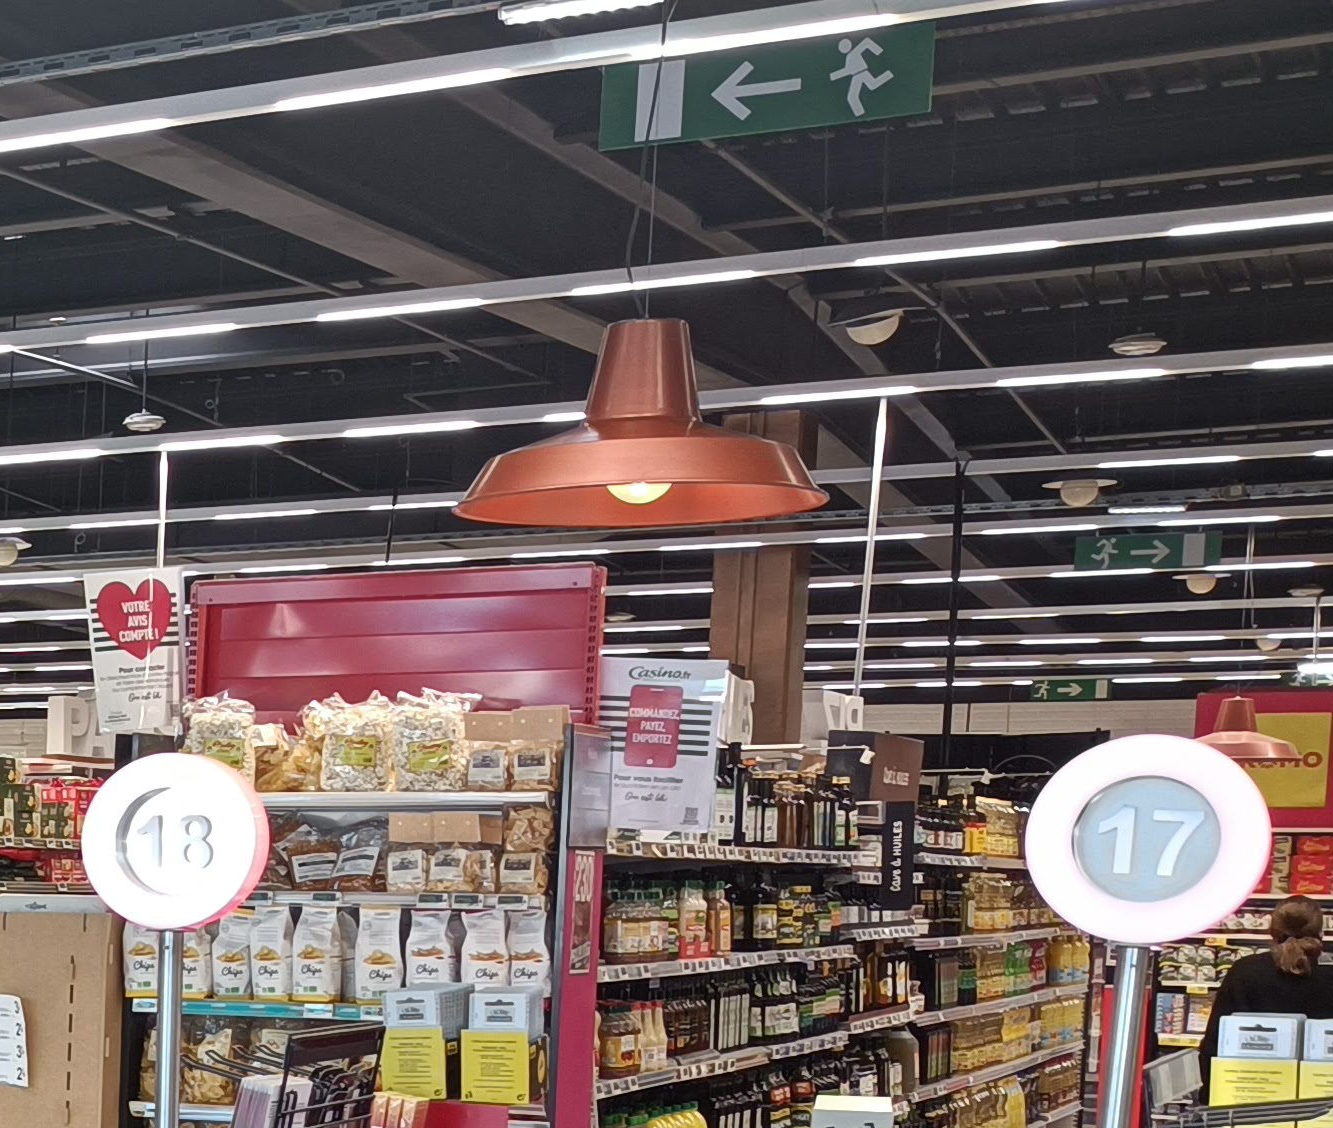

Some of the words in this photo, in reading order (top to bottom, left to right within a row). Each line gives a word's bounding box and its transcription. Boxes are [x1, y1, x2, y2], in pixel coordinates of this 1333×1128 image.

[127, 615, 148, 628] AVIS
[136, 814, 215, 869] 18
[892, 820, 903, 855] HUILES
[1097, 804, 1206, 877] 17
[221, 966, 244, 980] Chips
[257, 966, 279, 979] Chips
[300, 964, 323, 978] Chips
[369, 969, 393, 984] Chips
[415, 963, 439, 977] Chips
[475, 968, 499, 983] Chips
[513, 967, 538, 983] Chips
